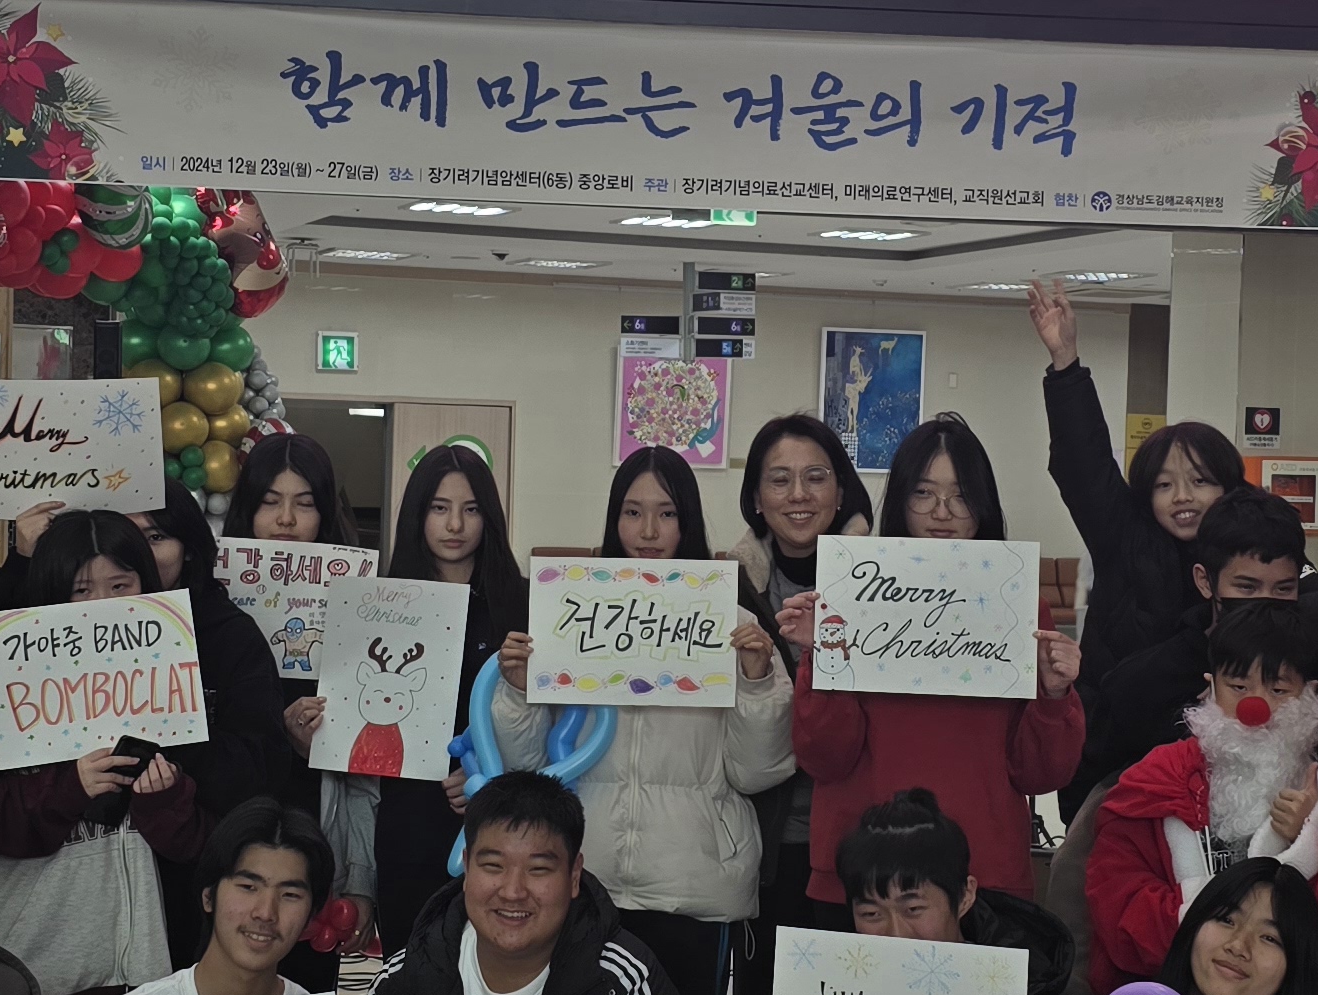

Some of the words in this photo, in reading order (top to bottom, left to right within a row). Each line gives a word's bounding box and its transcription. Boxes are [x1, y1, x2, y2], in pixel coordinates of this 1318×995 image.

[280, 50, 447, 130] 함께
[477, 60, 697, 140] 만드는
[722, 70, 923, 152] 겨울의
[950, 81, 1078, 157] 기적
[141, 156, 166, 171] 일시
[180, 157, 223, 174] 2024년
[228, 157, 256, 175] 12월
[260, 158, 312, 178] 23일(월)
[328, 161, 379, 181] 27일(금)
[388, 167, 414, 182] 장소
[428, 167, 574, 190] 장기려기념암센터(6동)
[577, 173, 634, 192] 중앙로비
[643, 177, 669, 193] 주관
[682, 177, 839, 201] 장기려기념의료선교센터,
[844, 183, 958, 206] 미래의료연구센터,
[962, 187, 1045, 207] 교직원선교회
[1054, 192, 1079, 208] 협찬
[851, 560, 967, 628] Merry
[2, 624, 84, 662] 가야중
[93, 619, 163, 653] BAND
[559, 598, 724, 657] 건강하세요
[860, 618, 1012, 662] Christmas
[5, 660, 200, 733] BOMBOCLAT
